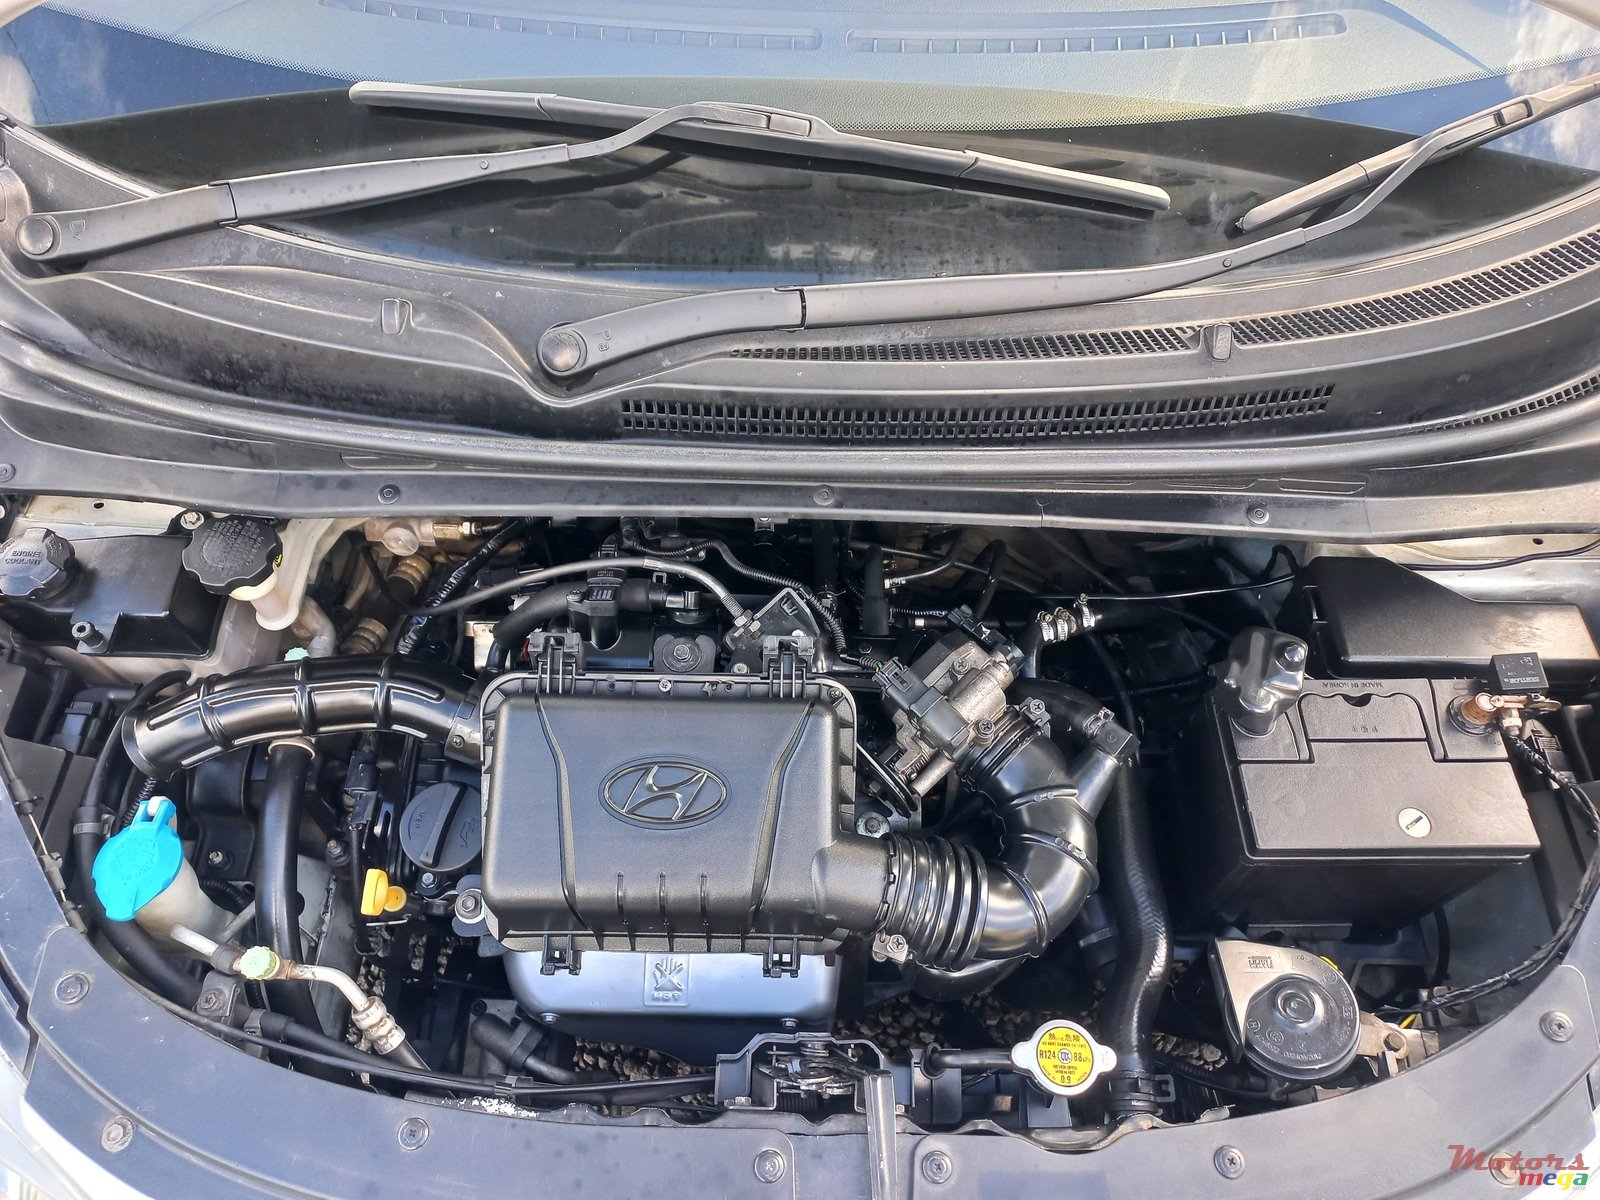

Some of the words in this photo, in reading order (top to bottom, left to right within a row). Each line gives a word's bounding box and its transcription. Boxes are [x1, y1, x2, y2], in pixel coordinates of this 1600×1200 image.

[4, 558, 43, 566] COOLANT
[1039, 1050, 1056, 1060] R124
[1060, 1075, 1071, 1084] 0.9
